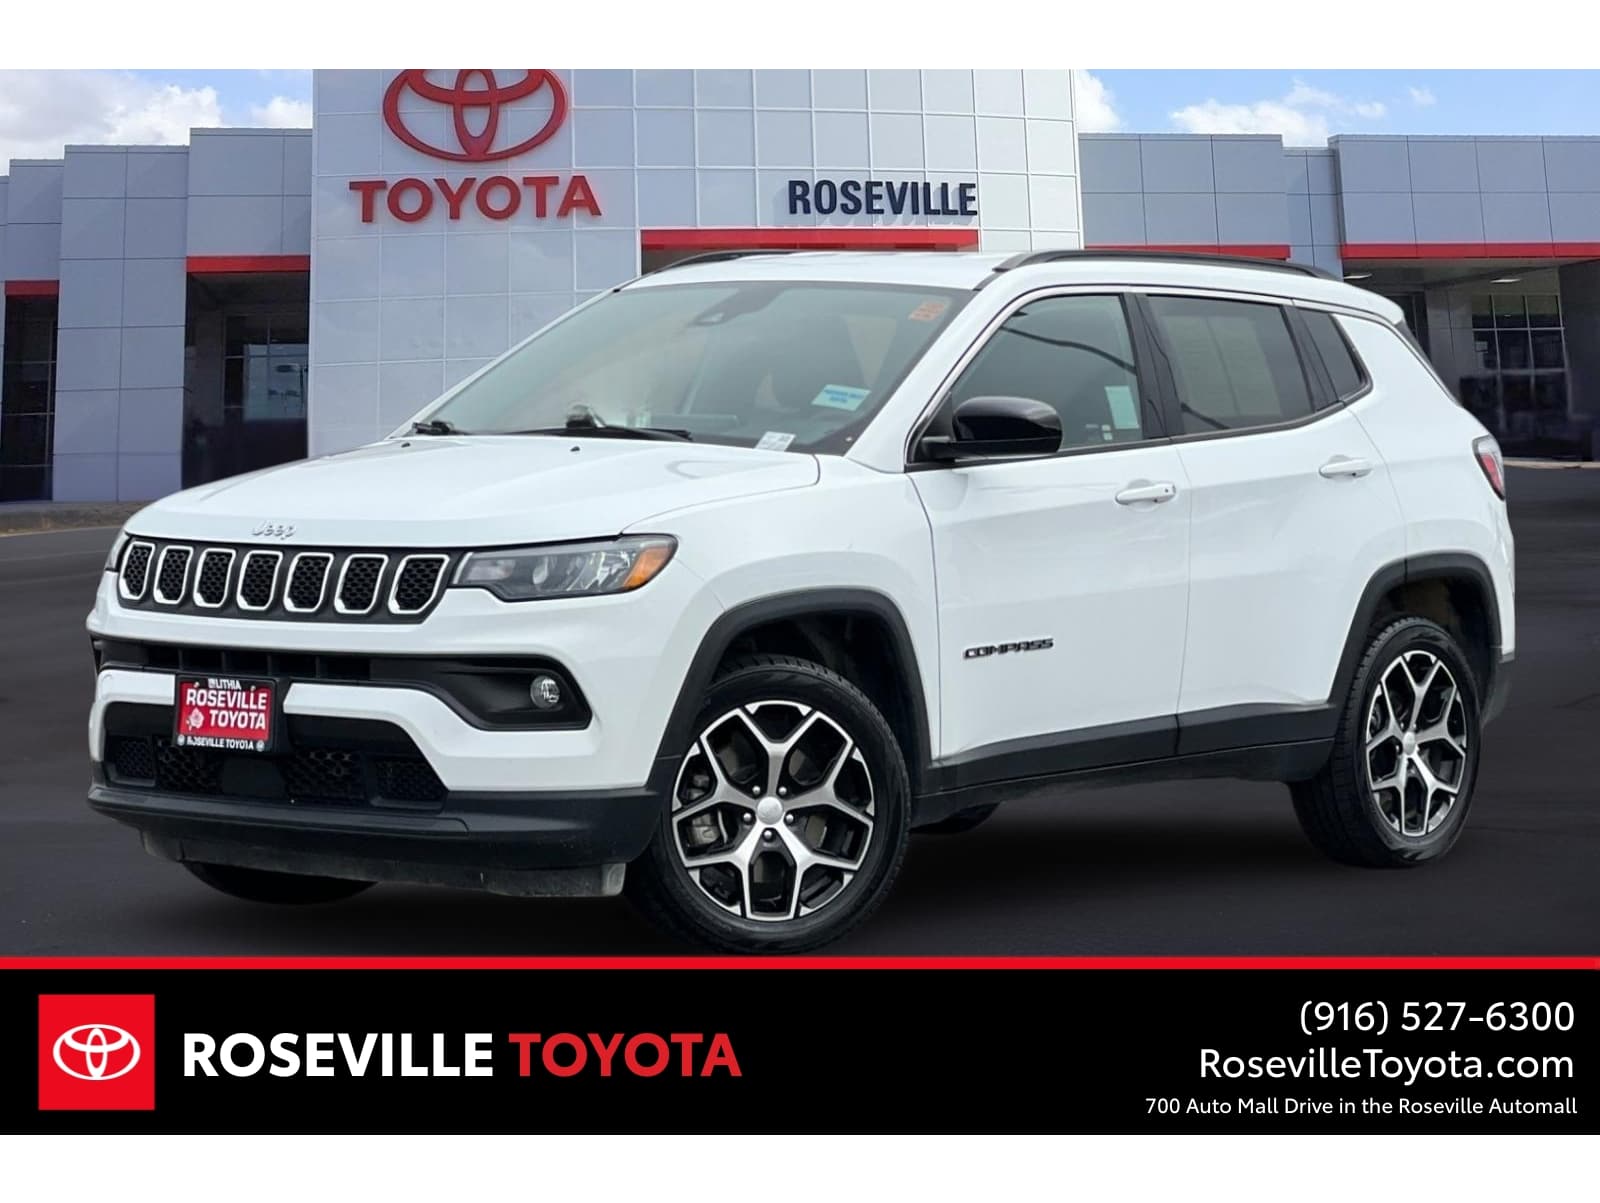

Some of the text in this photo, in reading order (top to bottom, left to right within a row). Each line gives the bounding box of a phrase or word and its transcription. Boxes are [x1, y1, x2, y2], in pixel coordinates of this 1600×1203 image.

[349, 175, 602, 223] TOYOTA
[788, 180, 978, 216] ROSEVILLE
[252, 520, 296, 540] Jeep
[964, 638, 1054, 659] COMPASS
[216, 679, 242, 690] LITHIA
[186, 688, 268, 710] ROSEVILLE
[209, 709, 266, 730] TOYOTA
[226, 738, 254, 750] TOYOTA
